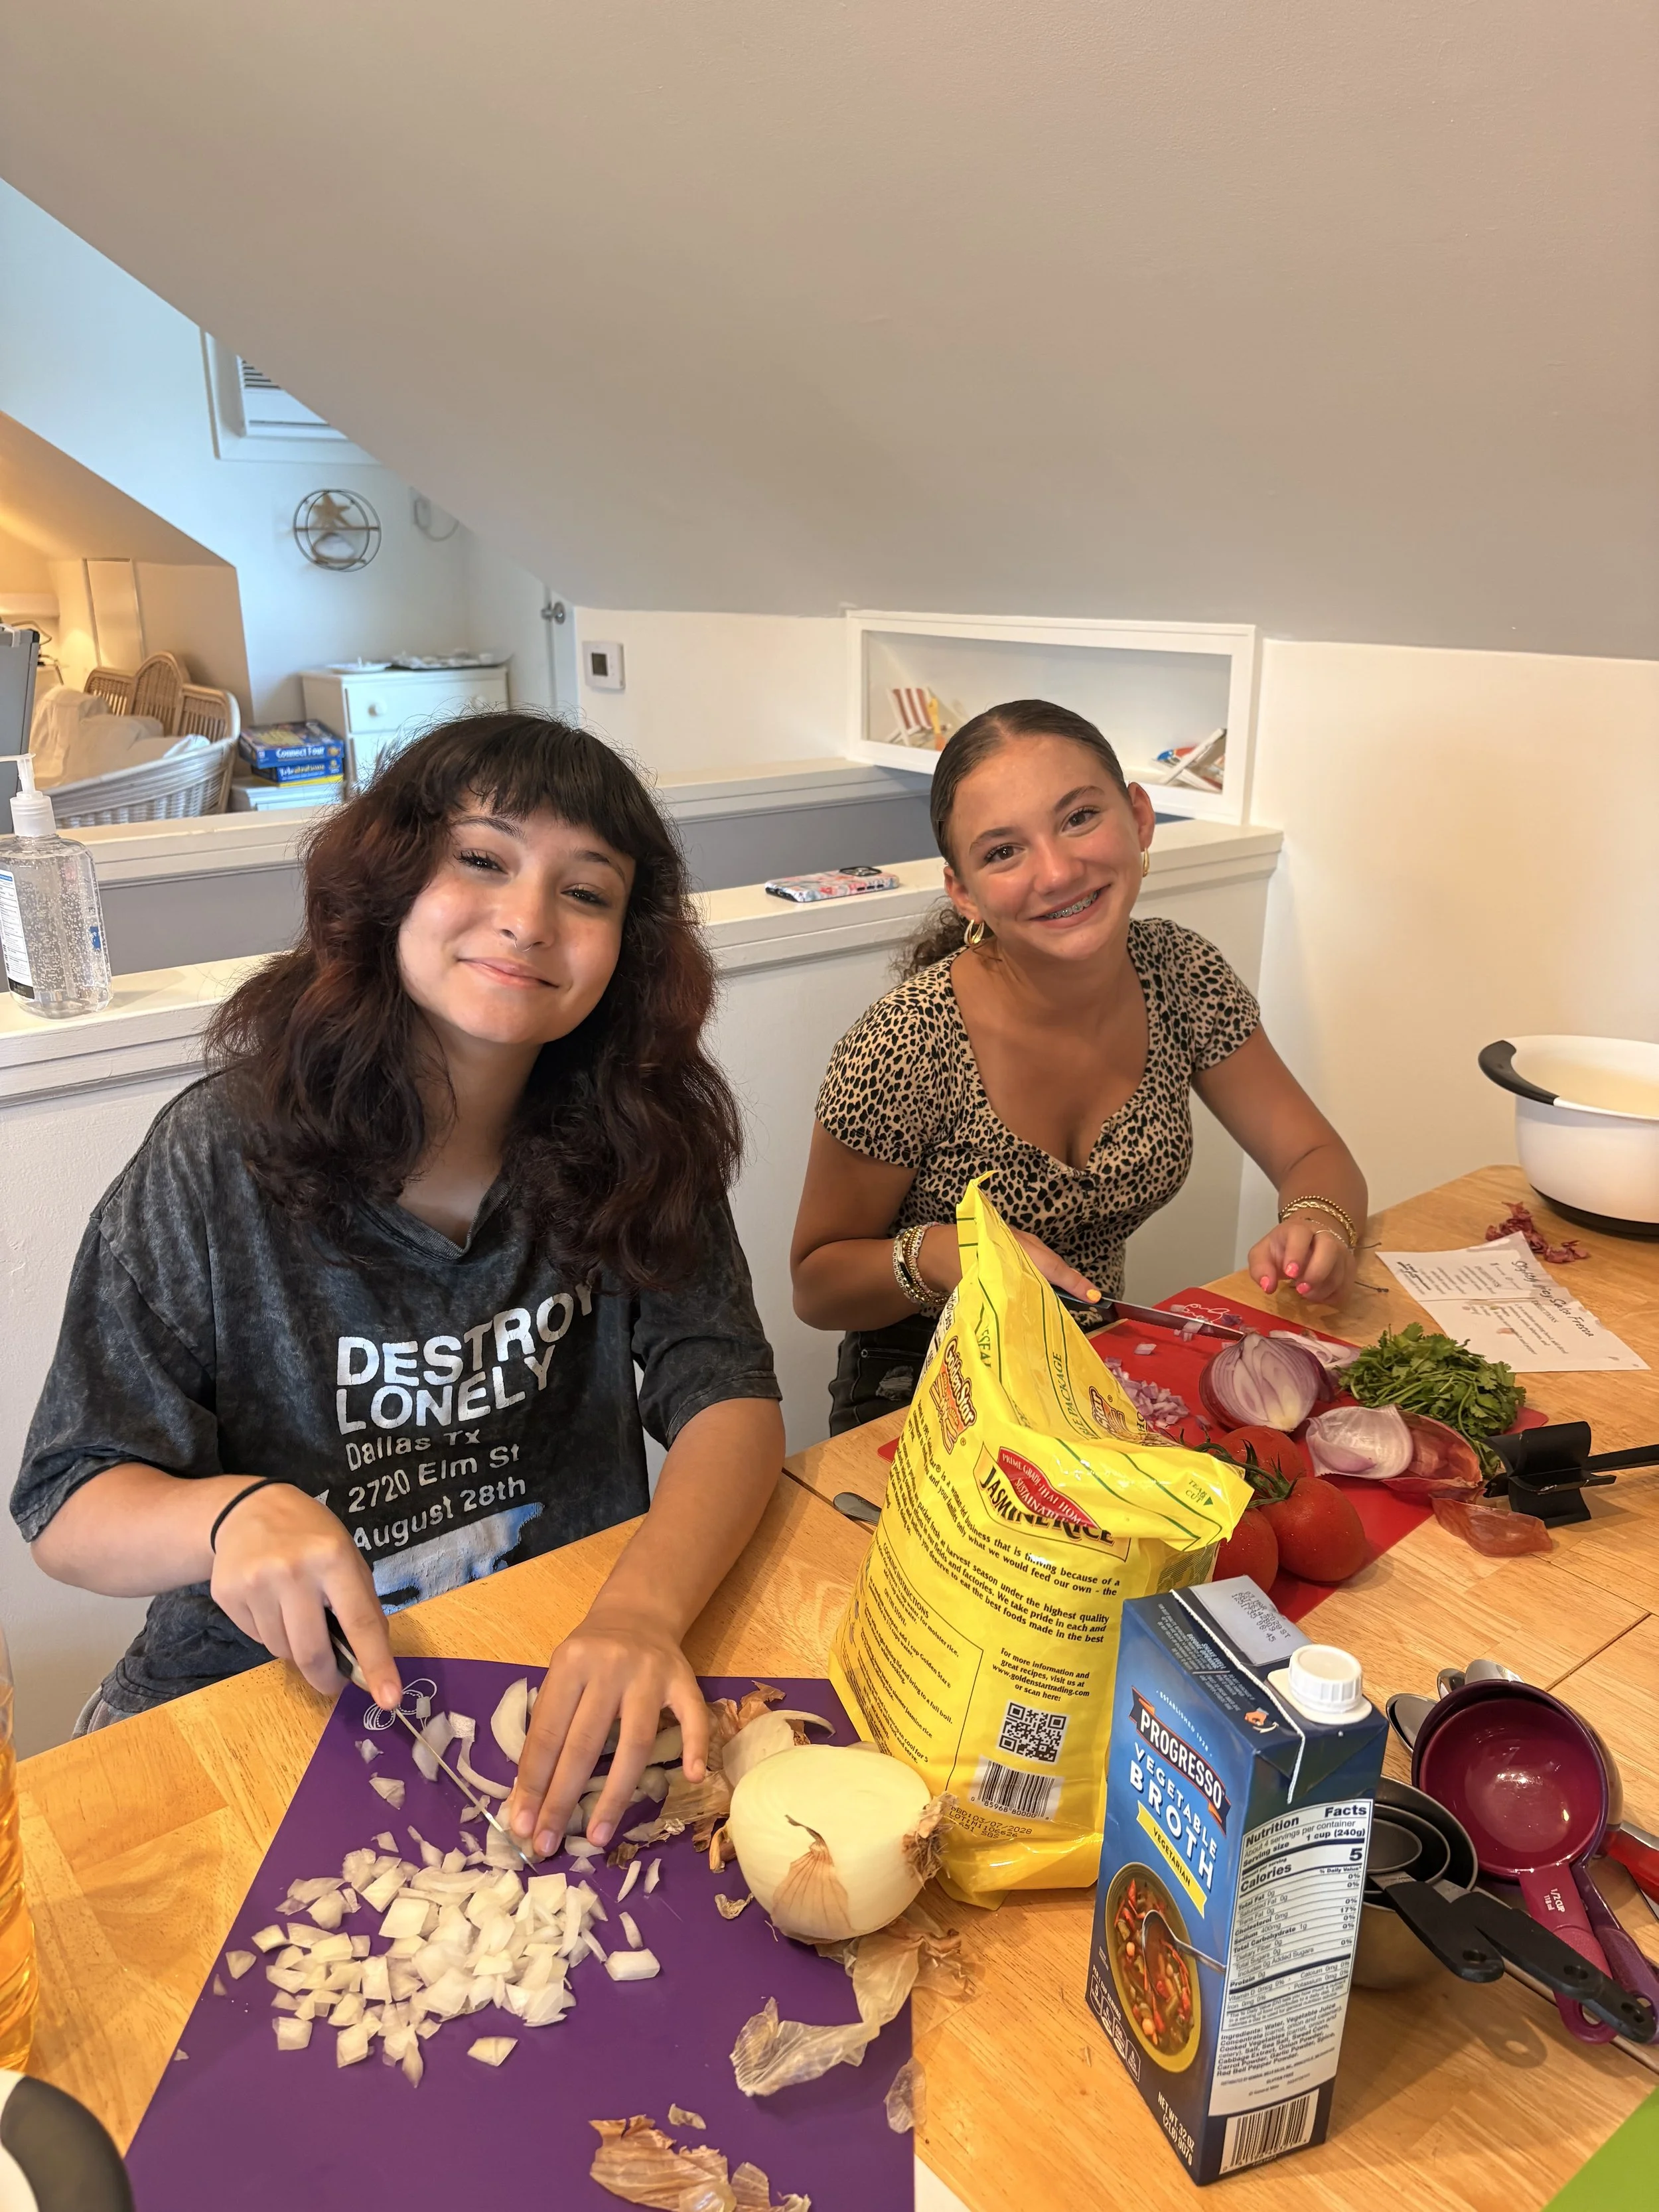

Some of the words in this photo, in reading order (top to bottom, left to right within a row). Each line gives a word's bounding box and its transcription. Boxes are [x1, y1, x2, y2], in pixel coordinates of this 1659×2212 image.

[276, 747, 306, 758] Connect
[308, 746, 325, 756] Four
[336, 1285, 591, 1386] DESTROY
[336, 1345, 555, 1435] LONELY
[957, 1378, 977, 1427] Star
[1052, 1352, 1079, 1418] PACKAGE
[346, 1436, 431, 1471] Dallas
[348, 1469, 410, 1512] 2720
[419, 1457, 477, 1487] Elm
[489, 1443, 519, 1467] St
[354, 1496, 454, 1551] August
[461, 1477, 525, 1512] 28th
[1039, 1484, 1059, 1505] THAI
[1059, 1501, 1082, 1524] HOM
[1185, 1490, 1204, 1503] CUT
[946, 1498, 958, 1523] families
[957, 1521, 966, 1538] only
[968, 1536, 989, 1551] what
[989, 1548, 1000, 1558] we
[1003, 1556, 1028, 1573] would
[1031, 1568, 1050, 1583] feed
[1054, 1578, 1070, 1589] our
[1072, 1585, 1092, 1593] own
[951, 1486, 968, 1518] woman-led
[965, 1514, 991, 1542] business
[994, 1540, 1011, 1552] that
[1014, 1546, 1021, 1557] is
[1061, 1567, 1098, 1584] because
[1102, 1577, 1111, 1585] of
[883, 1542, 897, 1575] COOKING
[896, 1572, 929, 1619] INSTRUCTIONS
[918, 1501, 932, 1524] packed
[930, 1521, 940, 1540] fresh
[946, 1544, 971, 1567] harvest
[973, 1565, 998, 1585] season
[1001, 1584, 1025, 1600] under
[1026, 1597, 1041, 1608] the
[1043, 1603, 1077, 1620] highest
[1080, 1613, 1110, 1625] quality
[929, 1550, 950, 1574] deserve
[960, 1578, 971, 1590] eat
[972, 1587, 983, 1599] the
[985, 1595, 1001, 1611] best
[1003, 1607, 1027, 1625] foods
[1029, 1621, 1054, 1635] made
[1056, 1627, 1065, 1639] in
[1067, 1632, 1082, 1643] the
[1085, 1634, 1104, 1643] best
[948, 1560, 962, 1573] and
[962, 1568, 995, 1596] factories.
[997, 1591, 1009, 1605] We
[1011, 1601, 1029, 1615] take
[1030, 1610, 1054, 1626] pride
[1056, 1617, 1064, 1628] in
[1067, 1621, 1088, 1632] each
[928, 1624, 946, 1647] moister
[946, 1642, 959, 1657] rice,
[920, 1654, 940, 1675] Golden
[992, 1664, 1090, 1697] www.goldenstartrading.com
[1000, 1659, 1019, 1671] great
[1020, 1667, 1048, 1680] recipes,
[1050, 1674, 1066, 1684] visit
[1001, 1647, 1011, 1658] For
[1012, 1655, 1031, 1666] more
[1032, 1660, 1074, 1677] information
[1023, 1687, 1041, 1697] scan
[1042, 1691, 1062, 1702] here:
[939, 1708, 953, 1724] boil.
[1160, 1692, 1195, 1732] ESTABLISHED
[1196, 1732, 1209, 1752] 1928
[1140, 1708, 1222, 1810] PROGRESSO
[984, 1800, 1009, 1812] 85968
[1011, 1808, 1037, 1818] 80000
[1135, 1741, 1217, 1860] VEGETABLE
[1129, 1759, 1214, 1891] BROTH
[1244, 1845, 1263, 1859] About
[1270, 1830, 1300, 1844] servings
[1302, 1826, 1314, 1835] per
[1317, 1820, 1356, 1830] container
[1246, 1816, 1299, 1848] Nutrition
[1325, 1805, 1367, 1818] Facts
[1153, 1827, 1191, 1887] VEGETARIAN
[1243, 1850, 1271, 1867] Serving
[1273, 1842, 1289, 1852] size
[1314, 1830, 1331, 1840] cup
[1334, 1828, 1365, 1838] (240g)
[1268, 1858, 1287, 1867] serving
[1240, 1864, 1291, 1891] Calories
[1349, 1848, 1362, 1861] 5
[1238, 1901, 1253, 1911] Total
[1254, 1895, 1264, 1903] Fat
[1555, 1899, 1565, 1912] CUP
[1234, 1931, 1258, 1945] Sodium
[1261, 1923, 1281, 1934] 400mg
[1234, 1944, 1250, 1954] Total
[1251, 1927, 1296, 1945] Carbohydrate
[1235, 1917, 1271, 1936] Cholesterol
[1293, 1948, 1314, 1958] Sugars
[1228, 1991, 1250, 2002] Vitamin
[1300, 1968, 1323, 1978] Calcium
[1230, 1976, 1256, 1987] Protein
[1294, 1977, 1323, 1990] Potassium
[1221, 2028, 1263, 2040] Ingredients:
[1158, 2091, 1169, 2113] NET
[1169, 2108, 1178, 2130] WT.
[1179, 2123, 1187, 2142] 32
[1187, 2135, 1194, 2152] OZ
[1163, 2113, 1178, 2142] (2LB)
